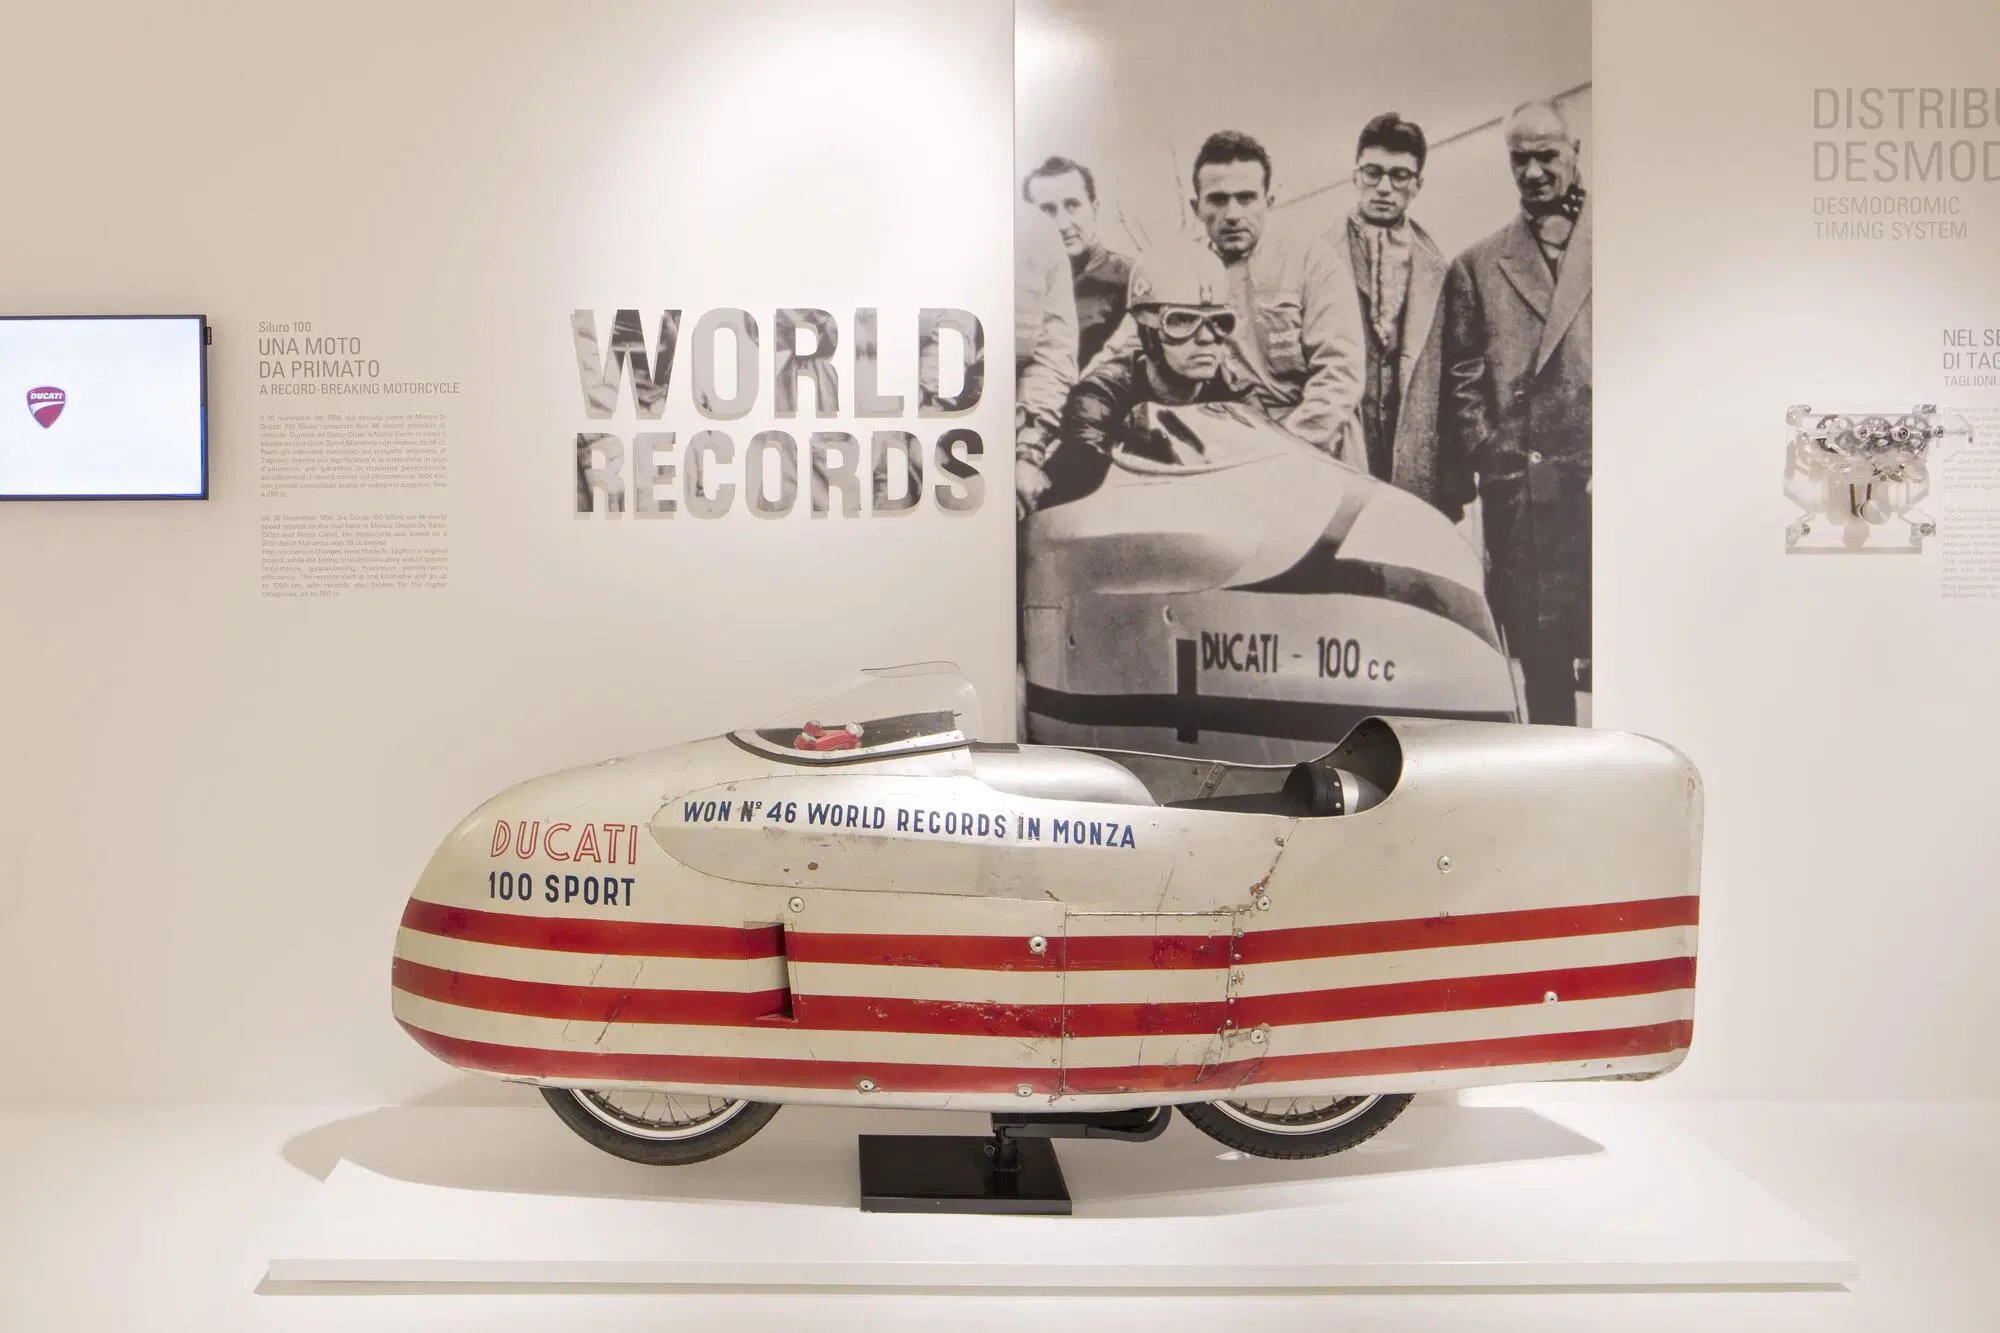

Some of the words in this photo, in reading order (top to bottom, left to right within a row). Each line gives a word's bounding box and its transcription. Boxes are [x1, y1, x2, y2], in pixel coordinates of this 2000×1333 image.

[1813, 87, 2000, 129] DISTRIB
[1813, 196, 1960, 215] DESMODROMIC
[1814, 221, 1884, 240] TIMING
[1892, 221, 1967, 240] SYSTEM
[258, 321, 290, 333] Siluro
[293, 321, 312, 332] 100
[258, 337, 300, 356] UNA
[305, 337, 361, 355] MOTO
[1943, 329, 1978, 347] NEL
[259, 361, 286, 378] DA
[292, 359, 380, 378] PRIMATO
[571, 307, 985, 420] WORLD
[1943, 352, 1960, 370] DI
[260, 384, 268, 395] A
[271, 383, 380, 395] RECORD-BREAKING
[383, 382, 460, 395] MOTORCYCLE
[1943, 375, 1997, 387] TAGLIONI
[30, 392, 63, 400] DUCATI
[573, 428, 986, 519] RECORDS
[1201, 631, 1279, 673] DUCATI
[1316, 636, 1361, 679] 100
[684, 801, 732, 822] WON
[766, 801, 798, 823] 46
[808, 802, 886, 830] WORLD
[897, 808, 1007, 839] RECORDS
[1017, 815, 1041, 841] IN
[1053, 818, 1137, 849] MONZA
[490, 820, 638, 865] DUCATI
[489, 871, 533, 901] 100
[544, 874, 636, 906] SPORT
